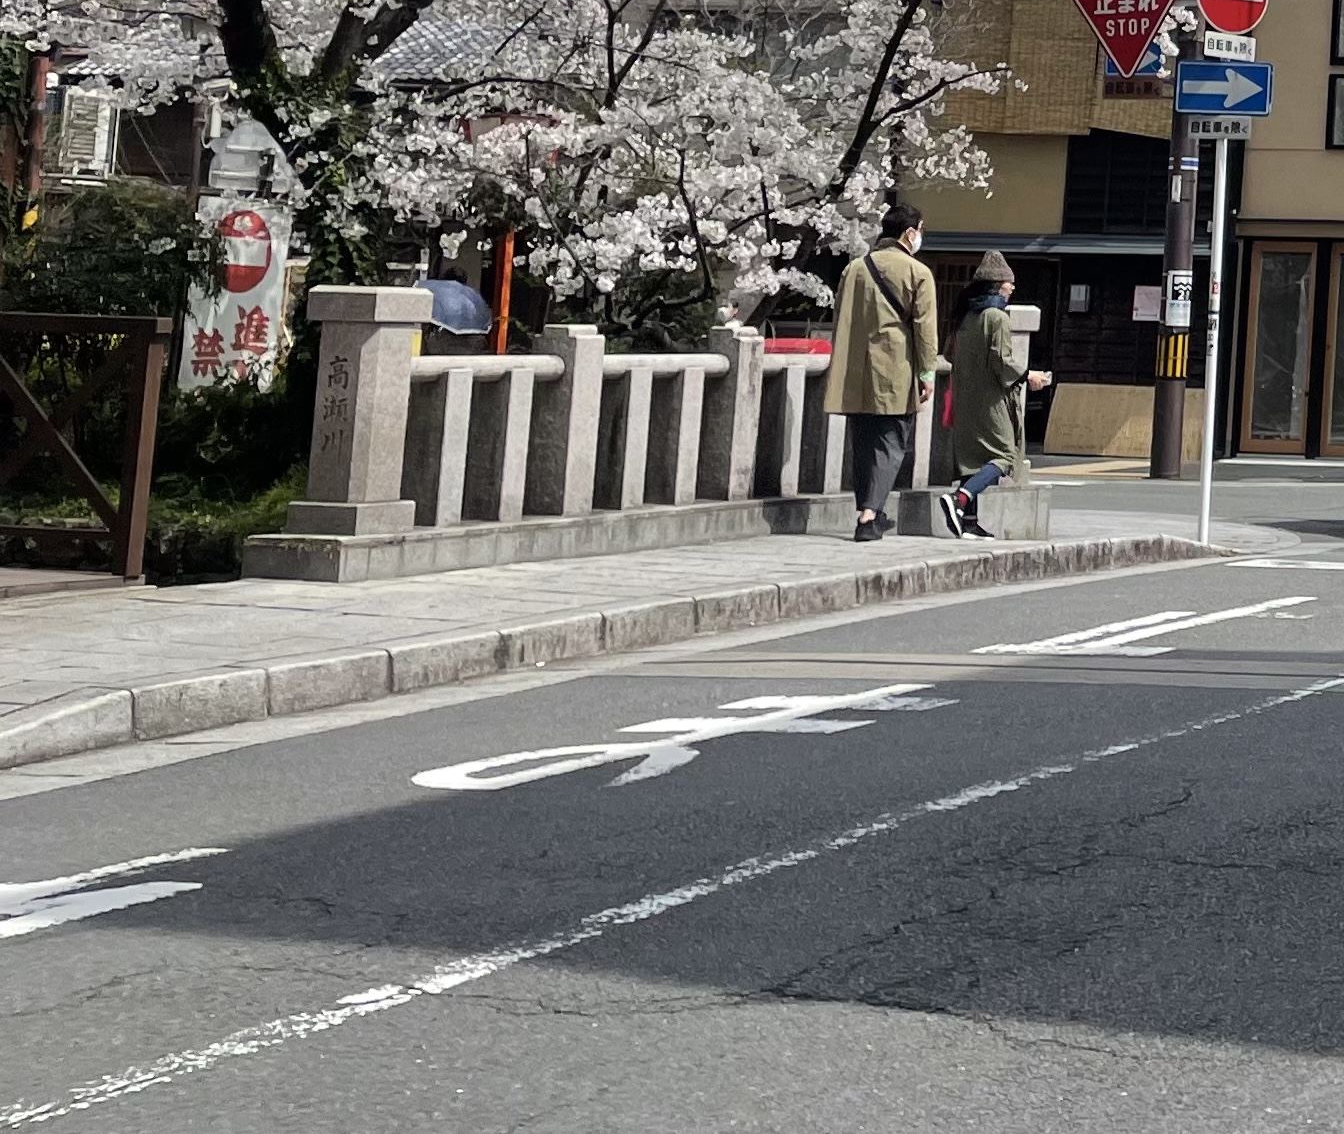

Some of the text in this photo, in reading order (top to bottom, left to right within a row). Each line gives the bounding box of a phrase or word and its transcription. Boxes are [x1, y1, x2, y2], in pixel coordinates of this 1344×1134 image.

[1106, 18, 1151, 36] STOP
[1206, 37, 1252, 56] 自転車を除く
[1190, 120, 1249, 135] 自転車を除く
